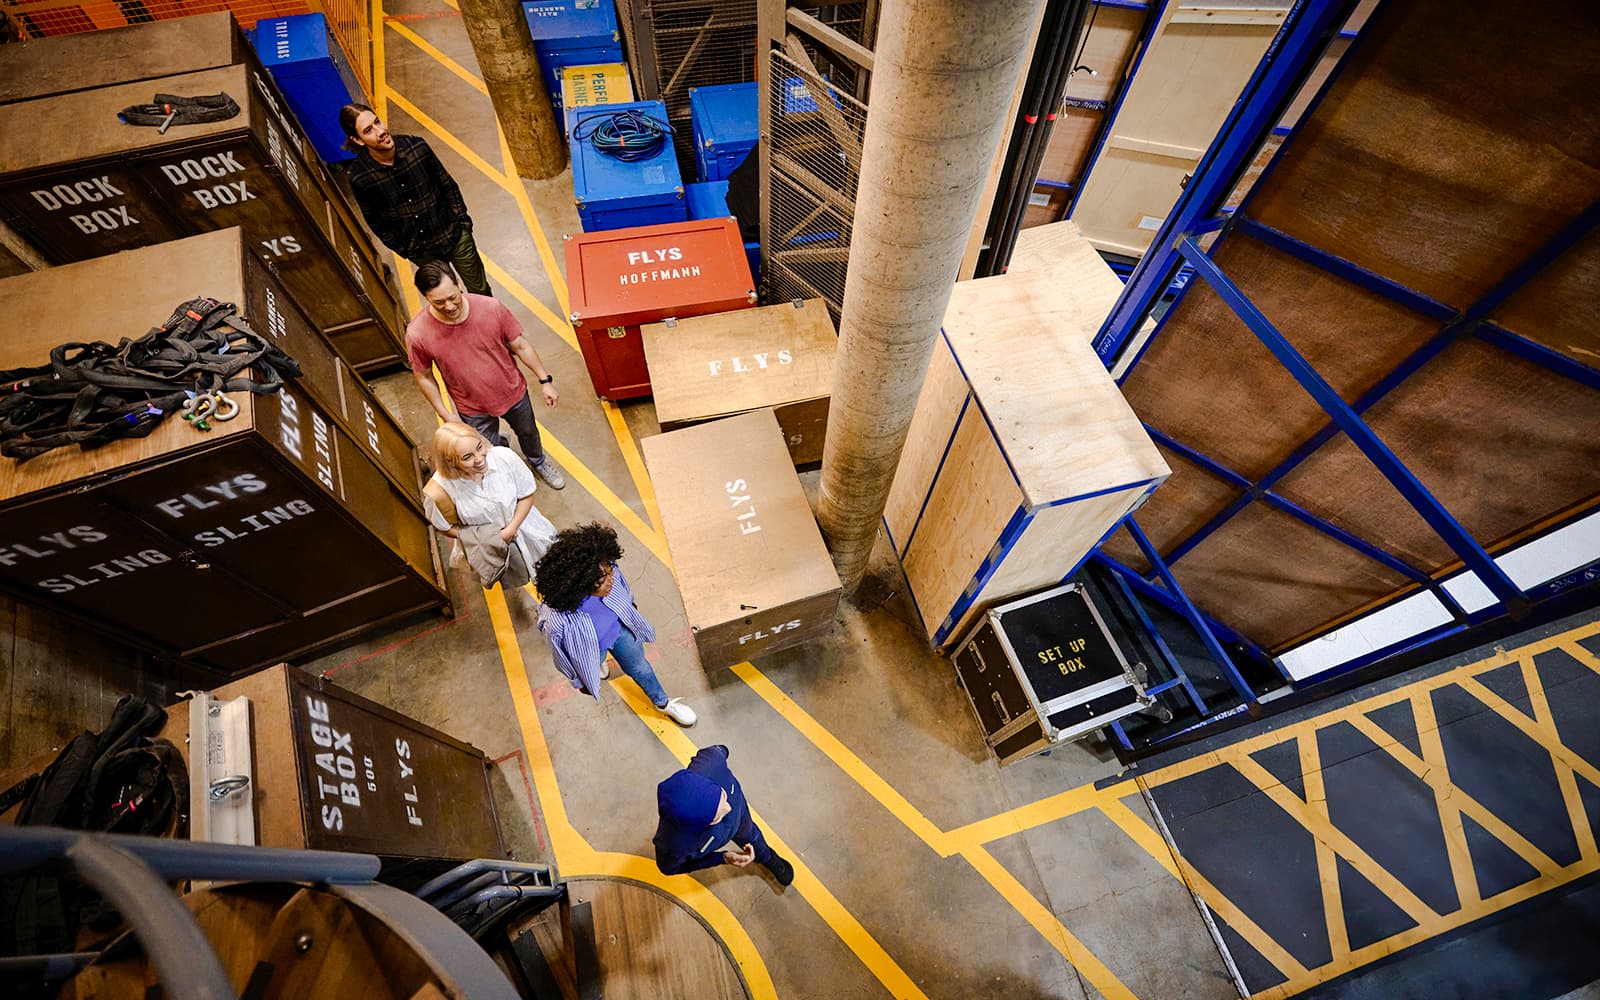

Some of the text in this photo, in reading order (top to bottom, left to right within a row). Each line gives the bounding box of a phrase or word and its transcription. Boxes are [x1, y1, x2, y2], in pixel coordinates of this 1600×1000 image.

[275, 21, 288, 38] TRIP
[160, 151, 246, 186] DOCK
[30, 176, 125, 211] DOCK
[192, 181, 257, 209] BOX
[69, 206, 140, 234] BOX
[261, 235, 302, 260] YS
[627, 247, 682, 266] FLYS
[619, 265, 701, 286] HOFFMANN
[708, 349, 793, 377] FLYS
[279, 387, 302, 461] FLYS
[363, 399, 381, 456] FLYS
[312, 411, 334, 492] SLING
[155, 473, 268, 519] FLYS
[725, 478, 762, 536] FLYS
[194, 499, 316, 548] SLING
[0, 525, 108, 567] FLYS
[37, 549, 172, 594] SLING
[738, 618, 802, 646] FLYS
[1037, 638, 1087, 665] SET UP
[1057, 656, 1087, 676] BOX
[306, 695, 344, 831] STAGE
[331, 727, 361, 807] BOX
[395, 737, 423, 827] FLYS
